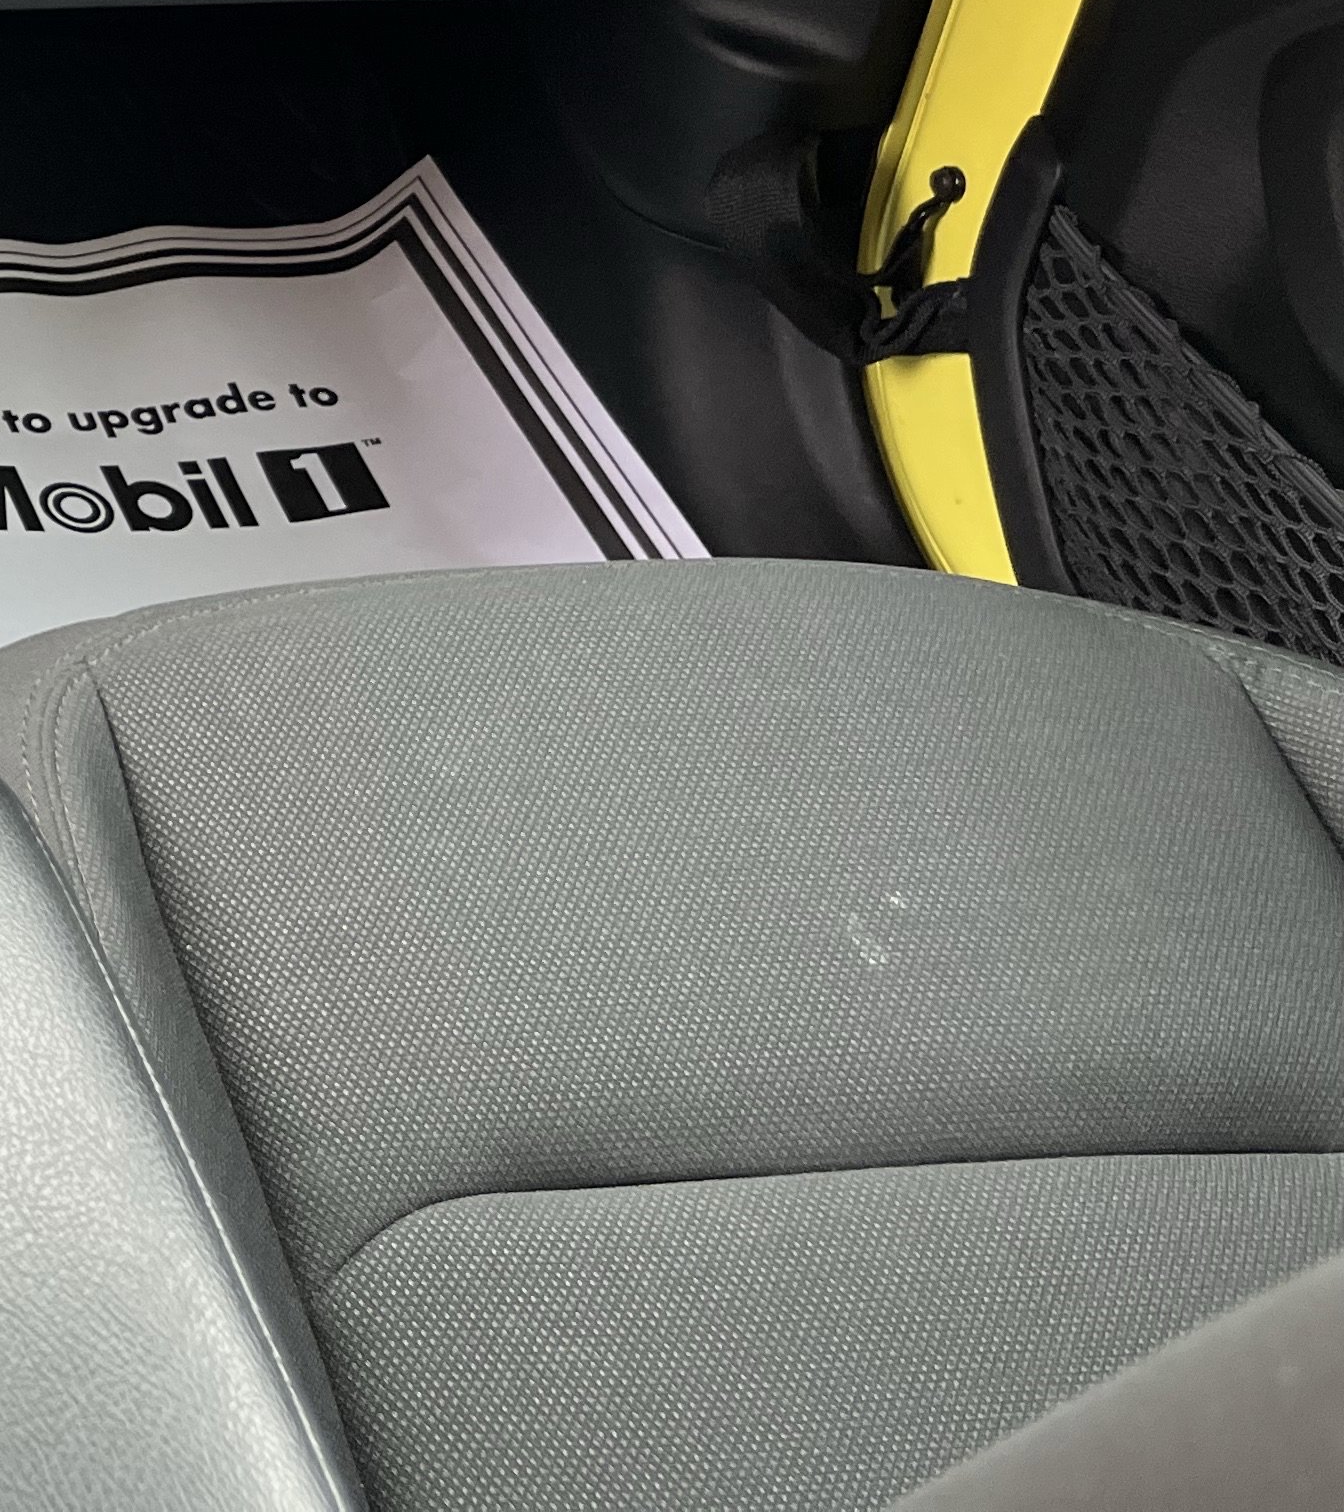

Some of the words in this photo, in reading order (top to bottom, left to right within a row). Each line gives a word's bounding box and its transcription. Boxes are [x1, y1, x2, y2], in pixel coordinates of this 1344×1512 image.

[1, 409, 52, 434] to
[67, 382, 276, 438] upgrade
[288, 383, 339, 408] to
